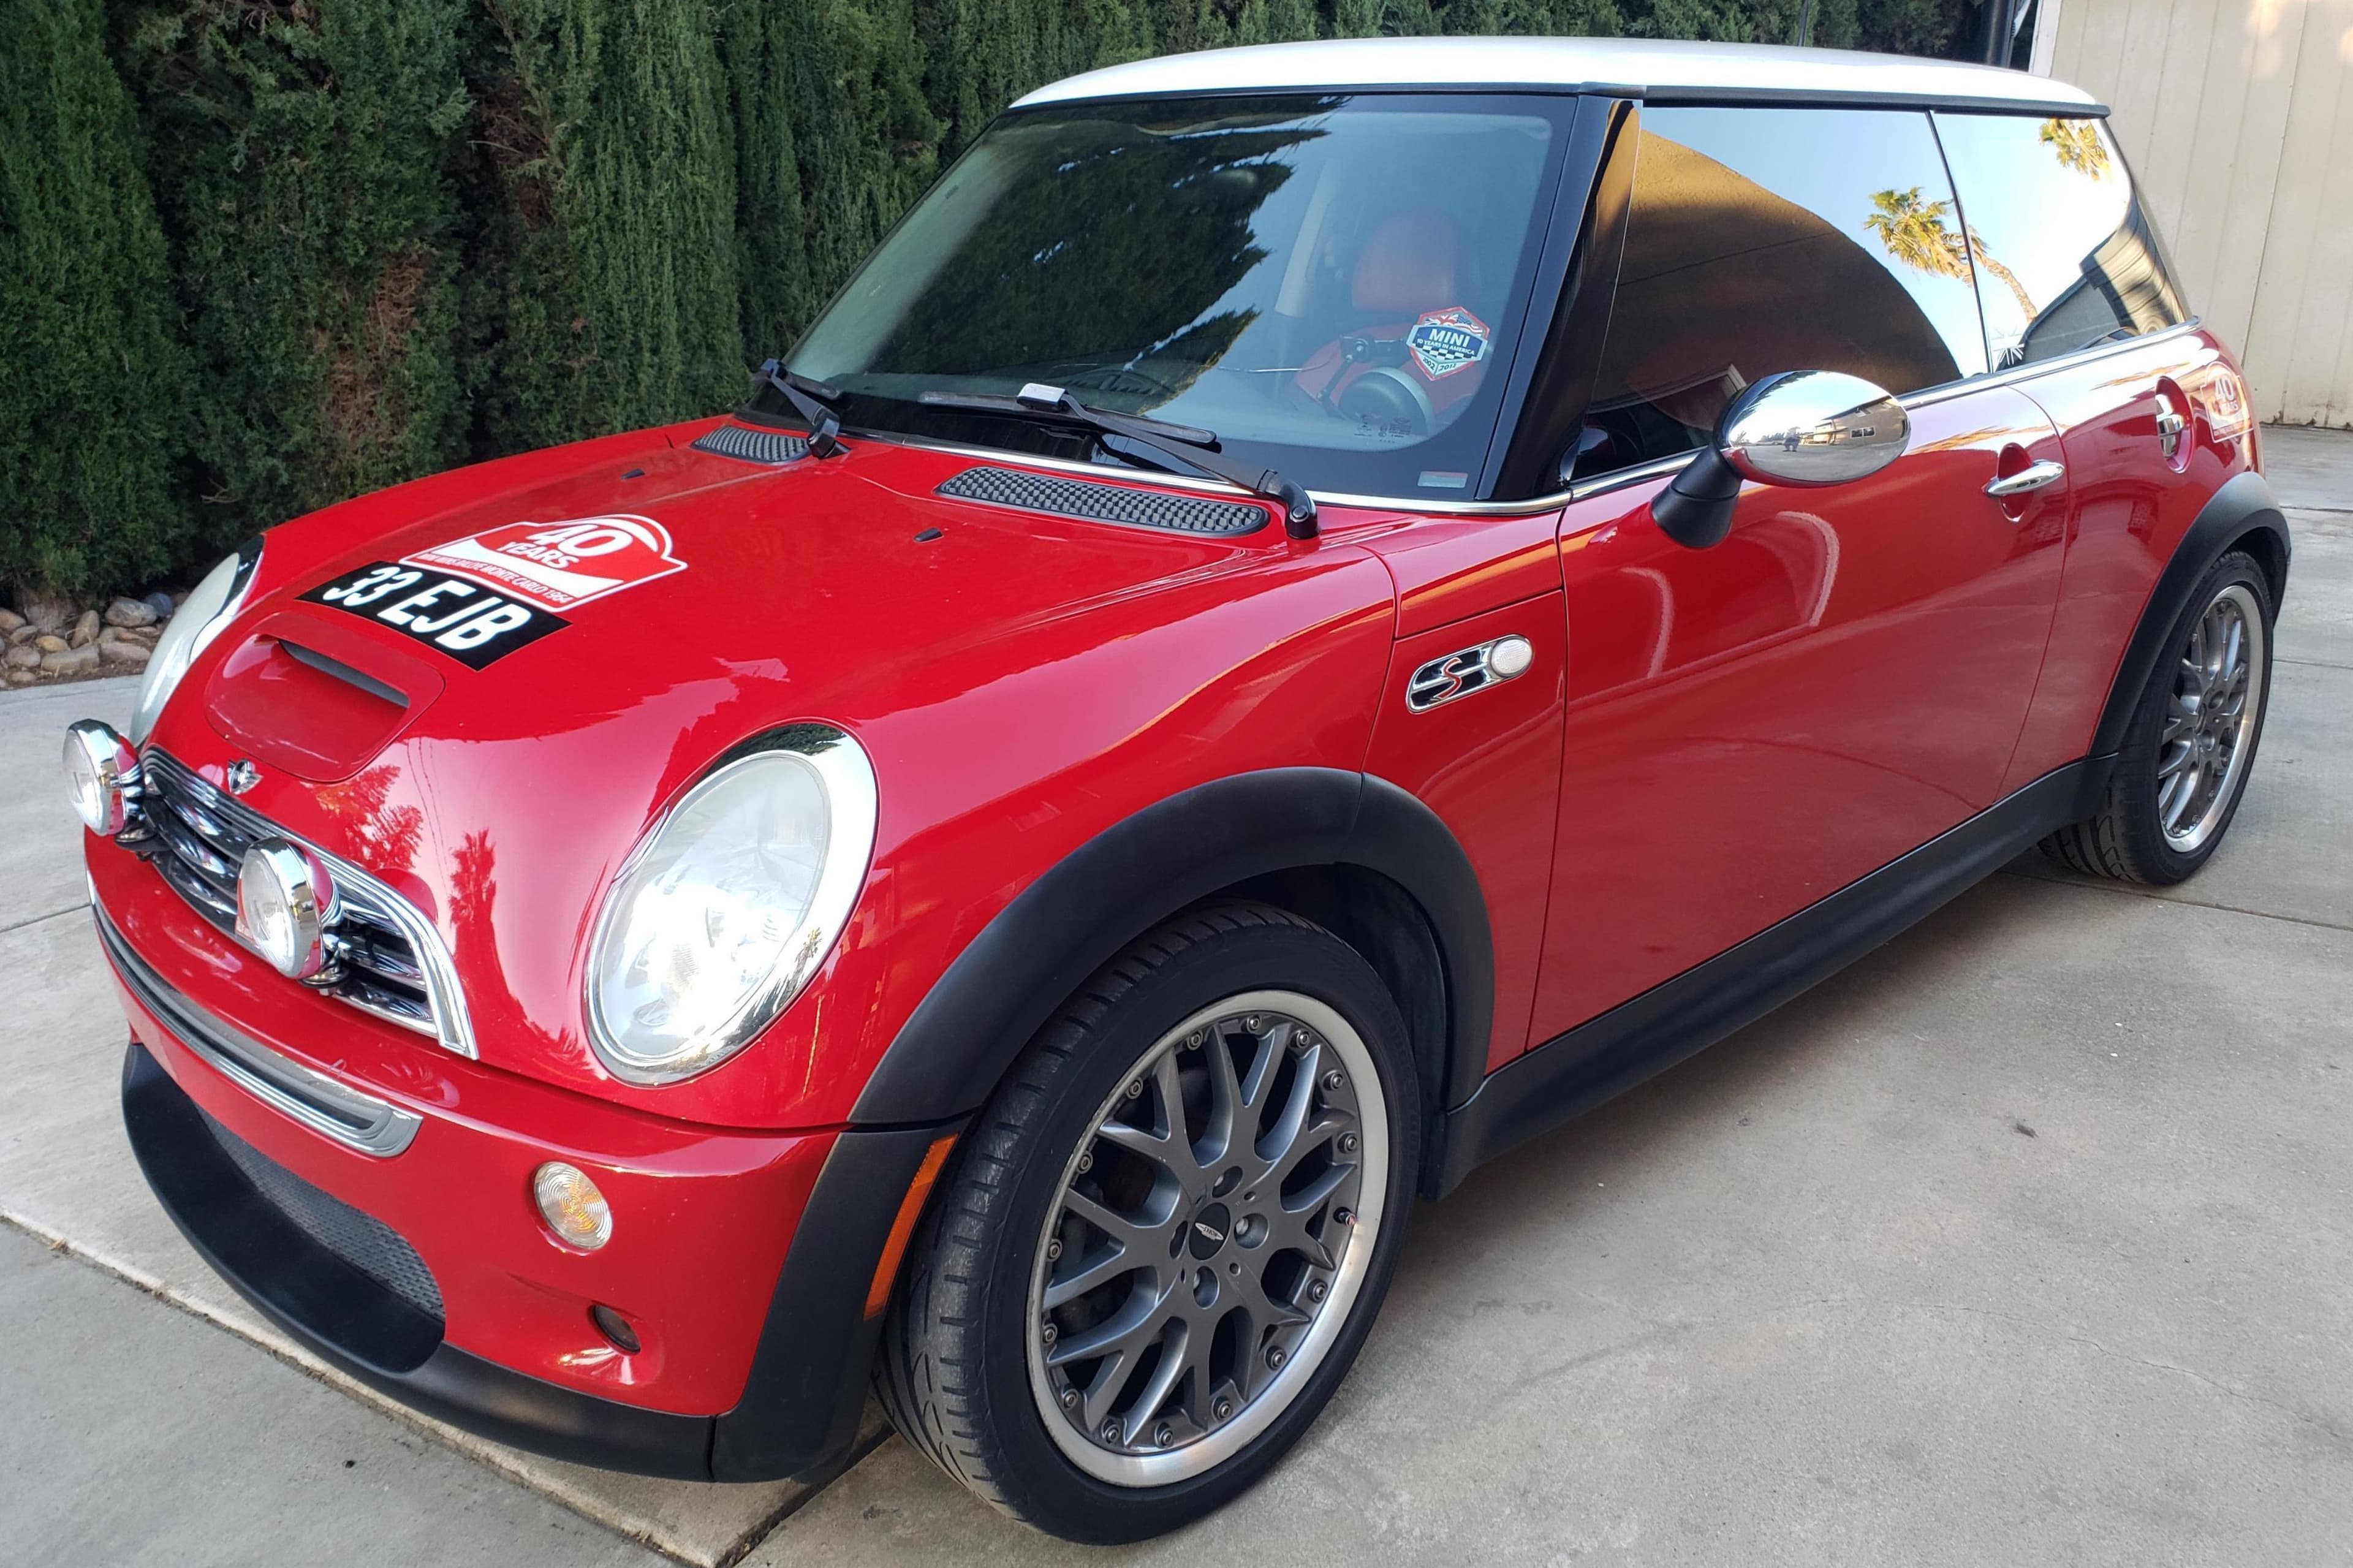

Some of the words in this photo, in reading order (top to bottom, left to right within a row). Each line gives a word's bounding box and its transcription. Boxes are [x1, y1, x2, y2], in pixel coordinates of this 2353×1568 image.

[1429, 328, 1470, 347] MINI
[1449, 345, 1474, 355] AMERICA
[1423, 357, 1435, 371] 2002
[2215, 376, 2235, 401] 40
[526, 524, 633, 557] 40
[497, 542, 580, 569] YEARS
[480, 565, 519, 581] MONTE
[512, 577, 549, 594] CARLO
[542, 589, 574, 604] 1964
[322, 567, 423, 606] 33
[377, 580, 532, 650] EJB
[1431, 657, 1463, 700] S
